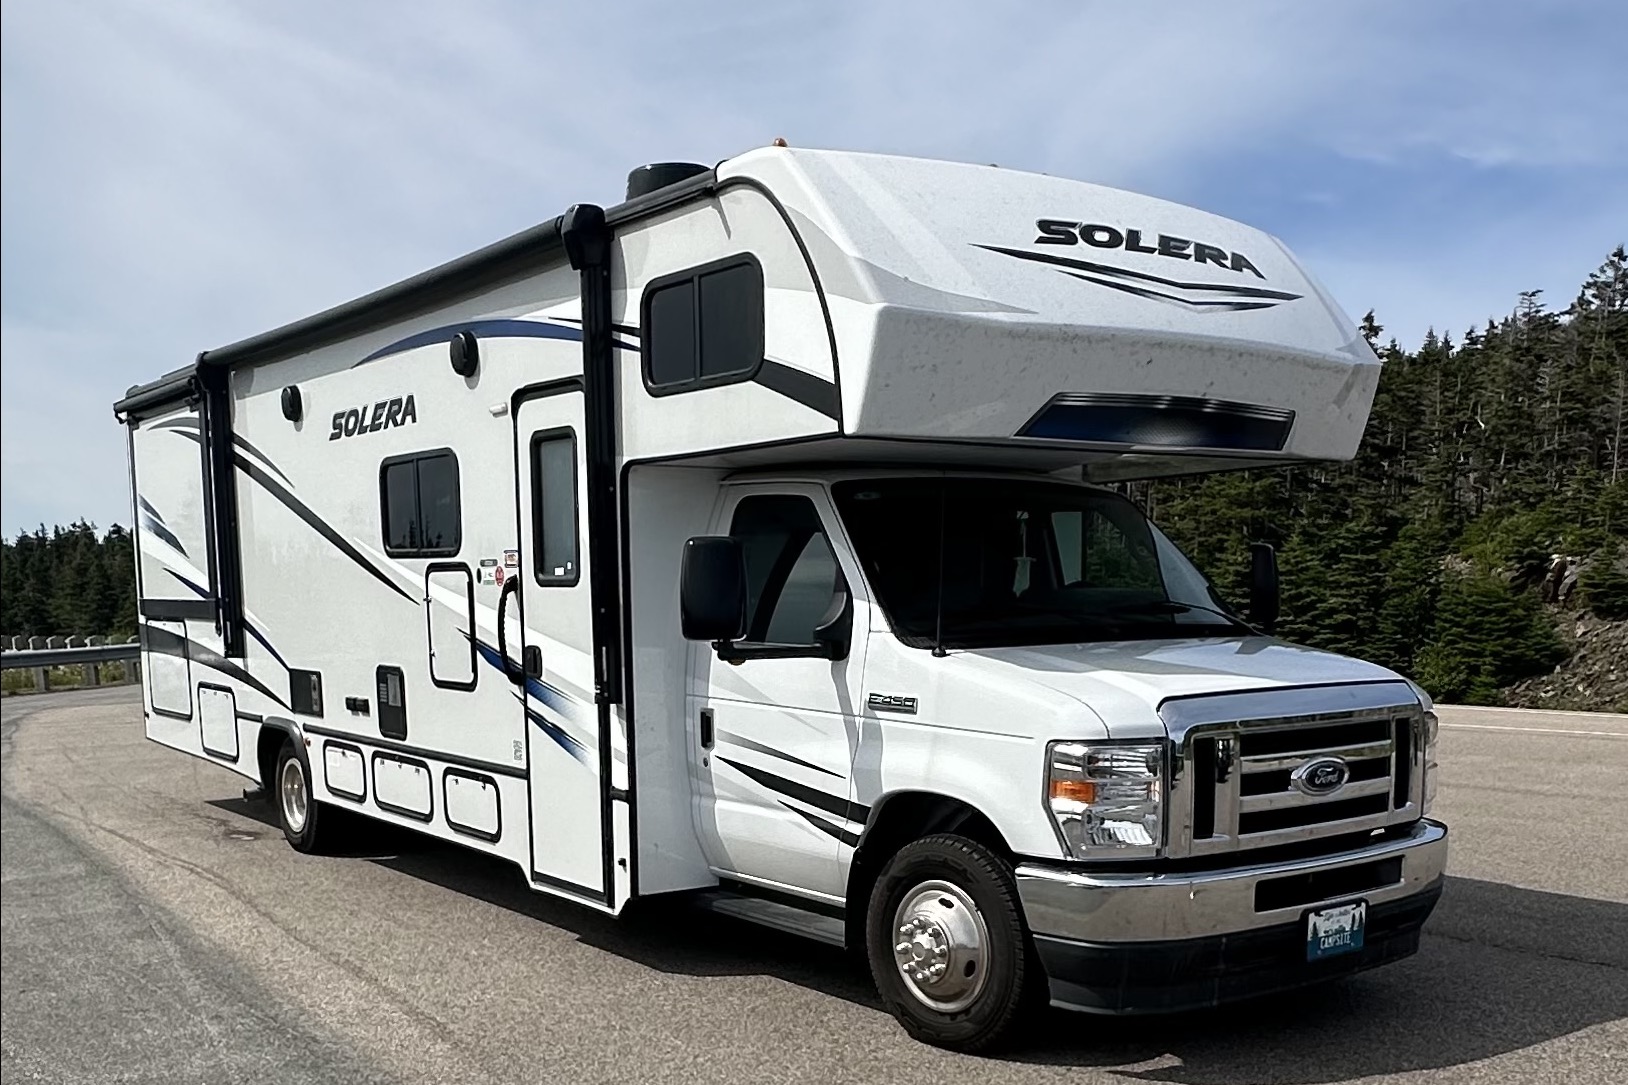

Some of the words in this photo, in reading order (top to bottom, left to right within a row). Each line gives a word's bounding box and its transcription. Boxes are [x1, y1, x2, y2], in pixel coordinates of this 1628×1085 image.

[1034, 218, 1267, 280] SOLERA
[329, 394, 417, 441] SOLERA
[1314, 767, 1340, 785] Ford
[1320, 931, 1352, 950] CAMPSITE
